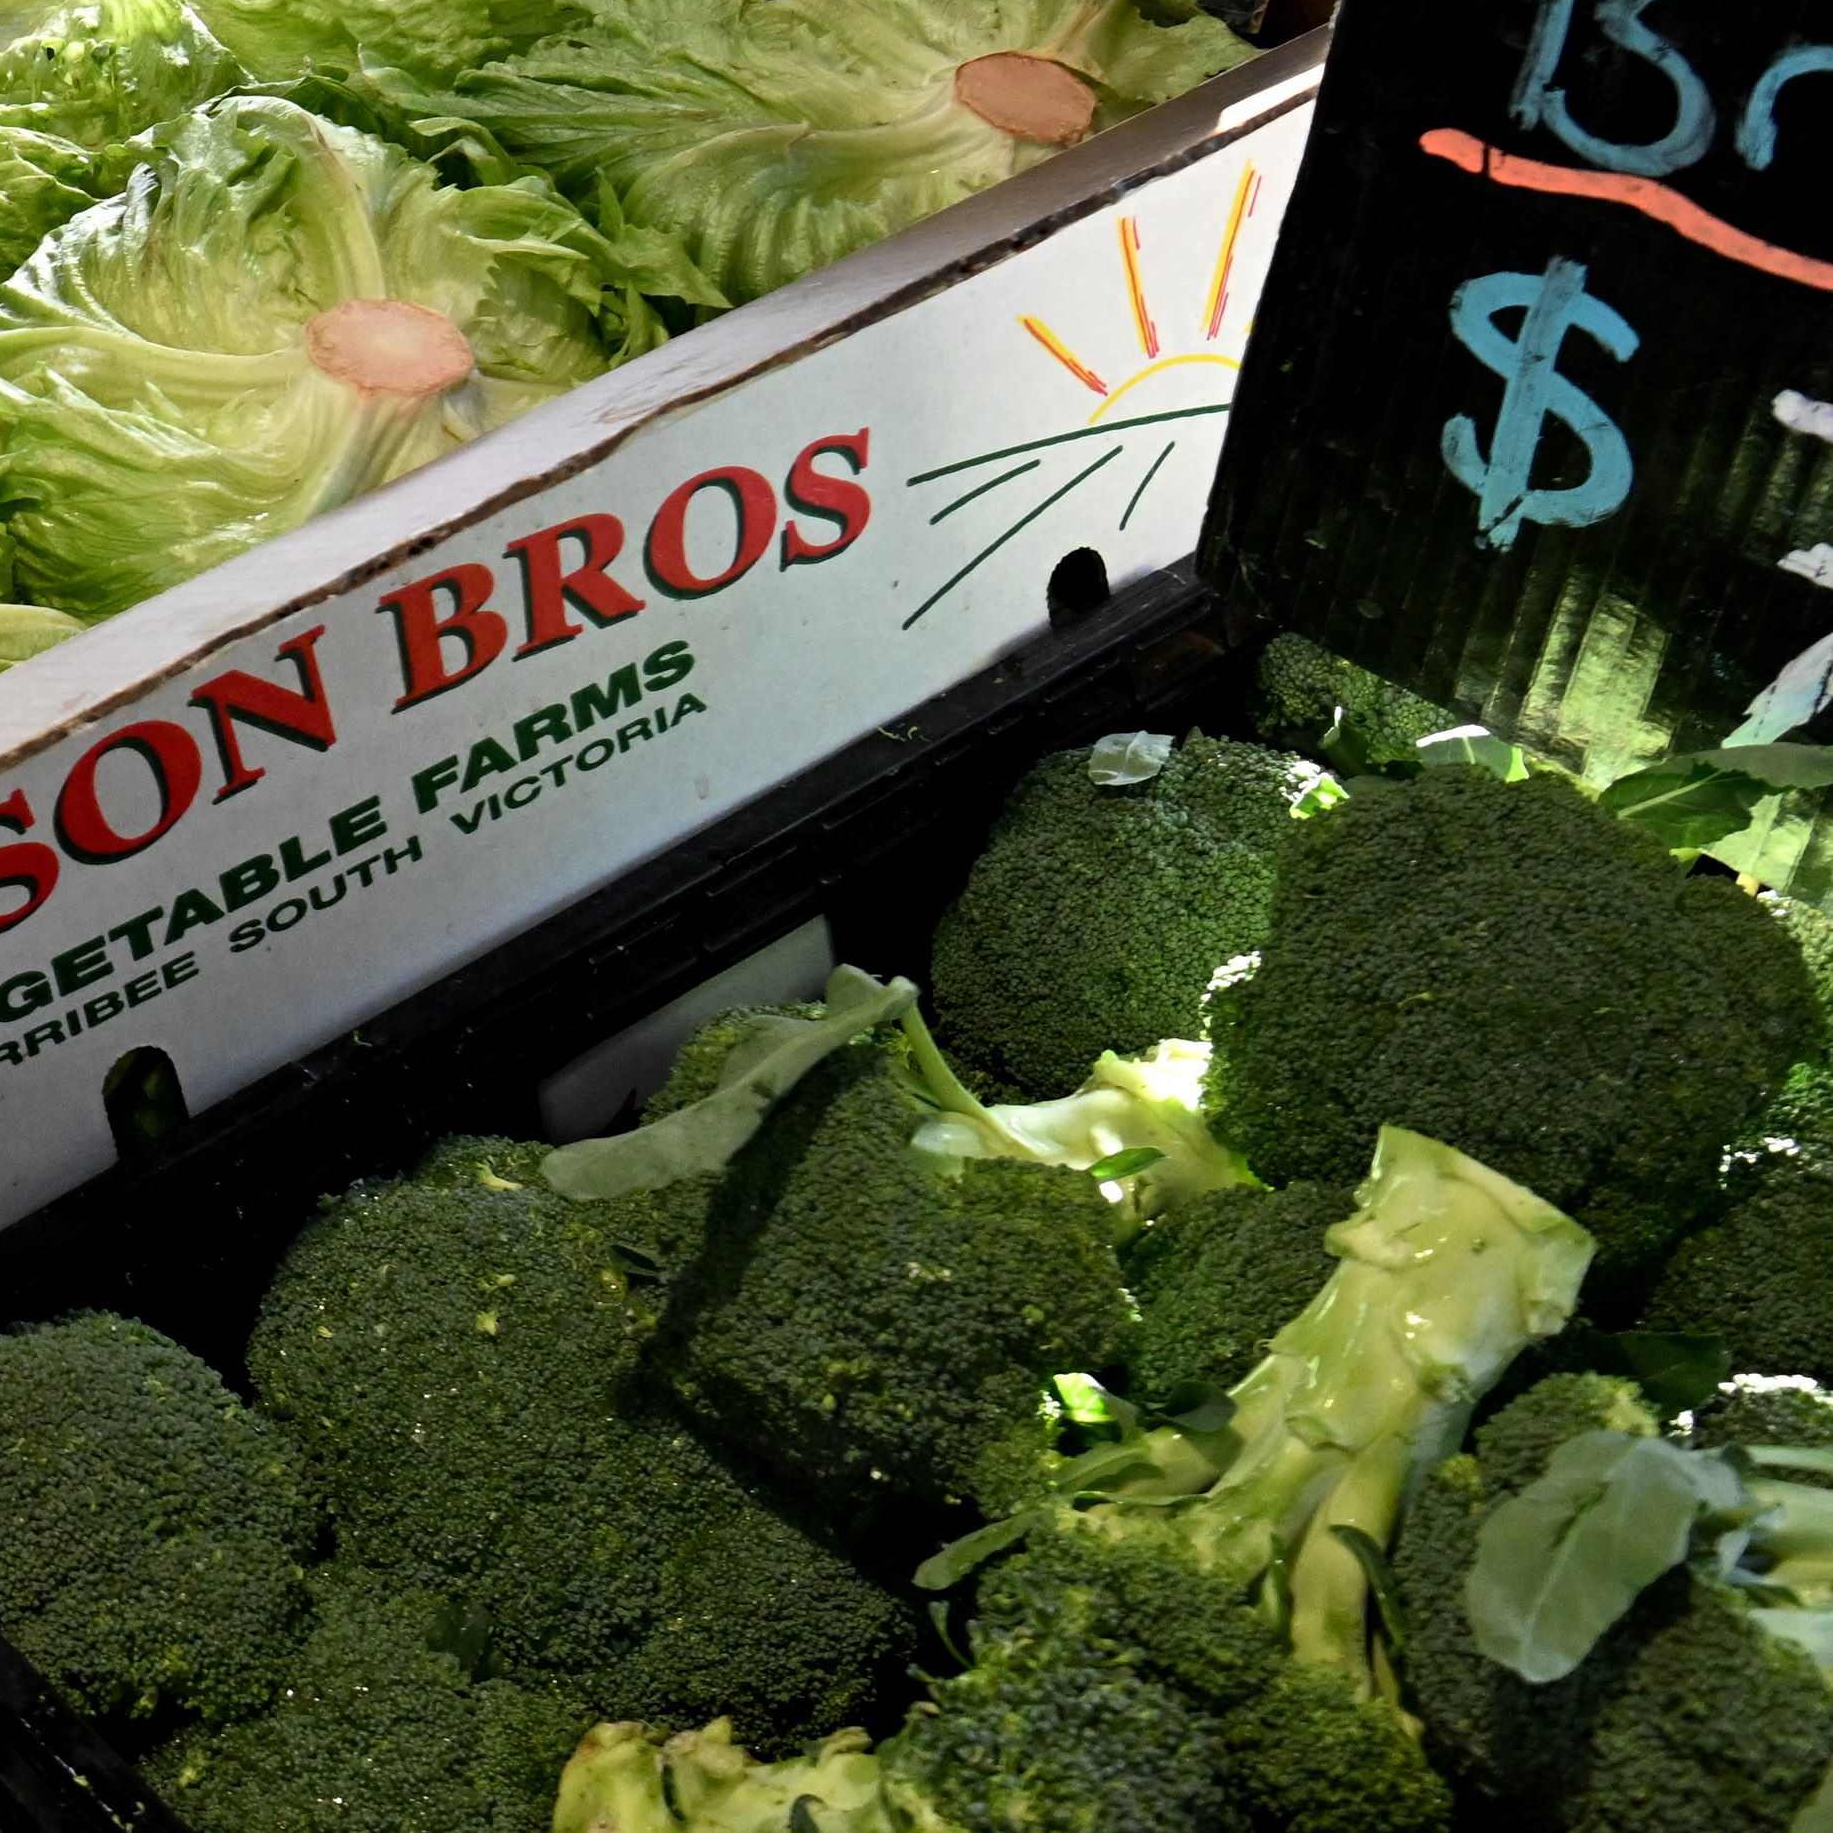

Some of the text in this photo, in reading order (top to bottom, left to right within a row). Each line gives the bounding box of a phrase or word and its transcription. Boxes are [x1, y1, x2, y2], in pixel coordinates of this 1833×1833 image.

[375, 425, 873, 714] BROS
[226, 835, 425, 955] SOUTH
[450, 691, 708, 837] VICTORIA
[411, 638, 697, 819] FARMS
